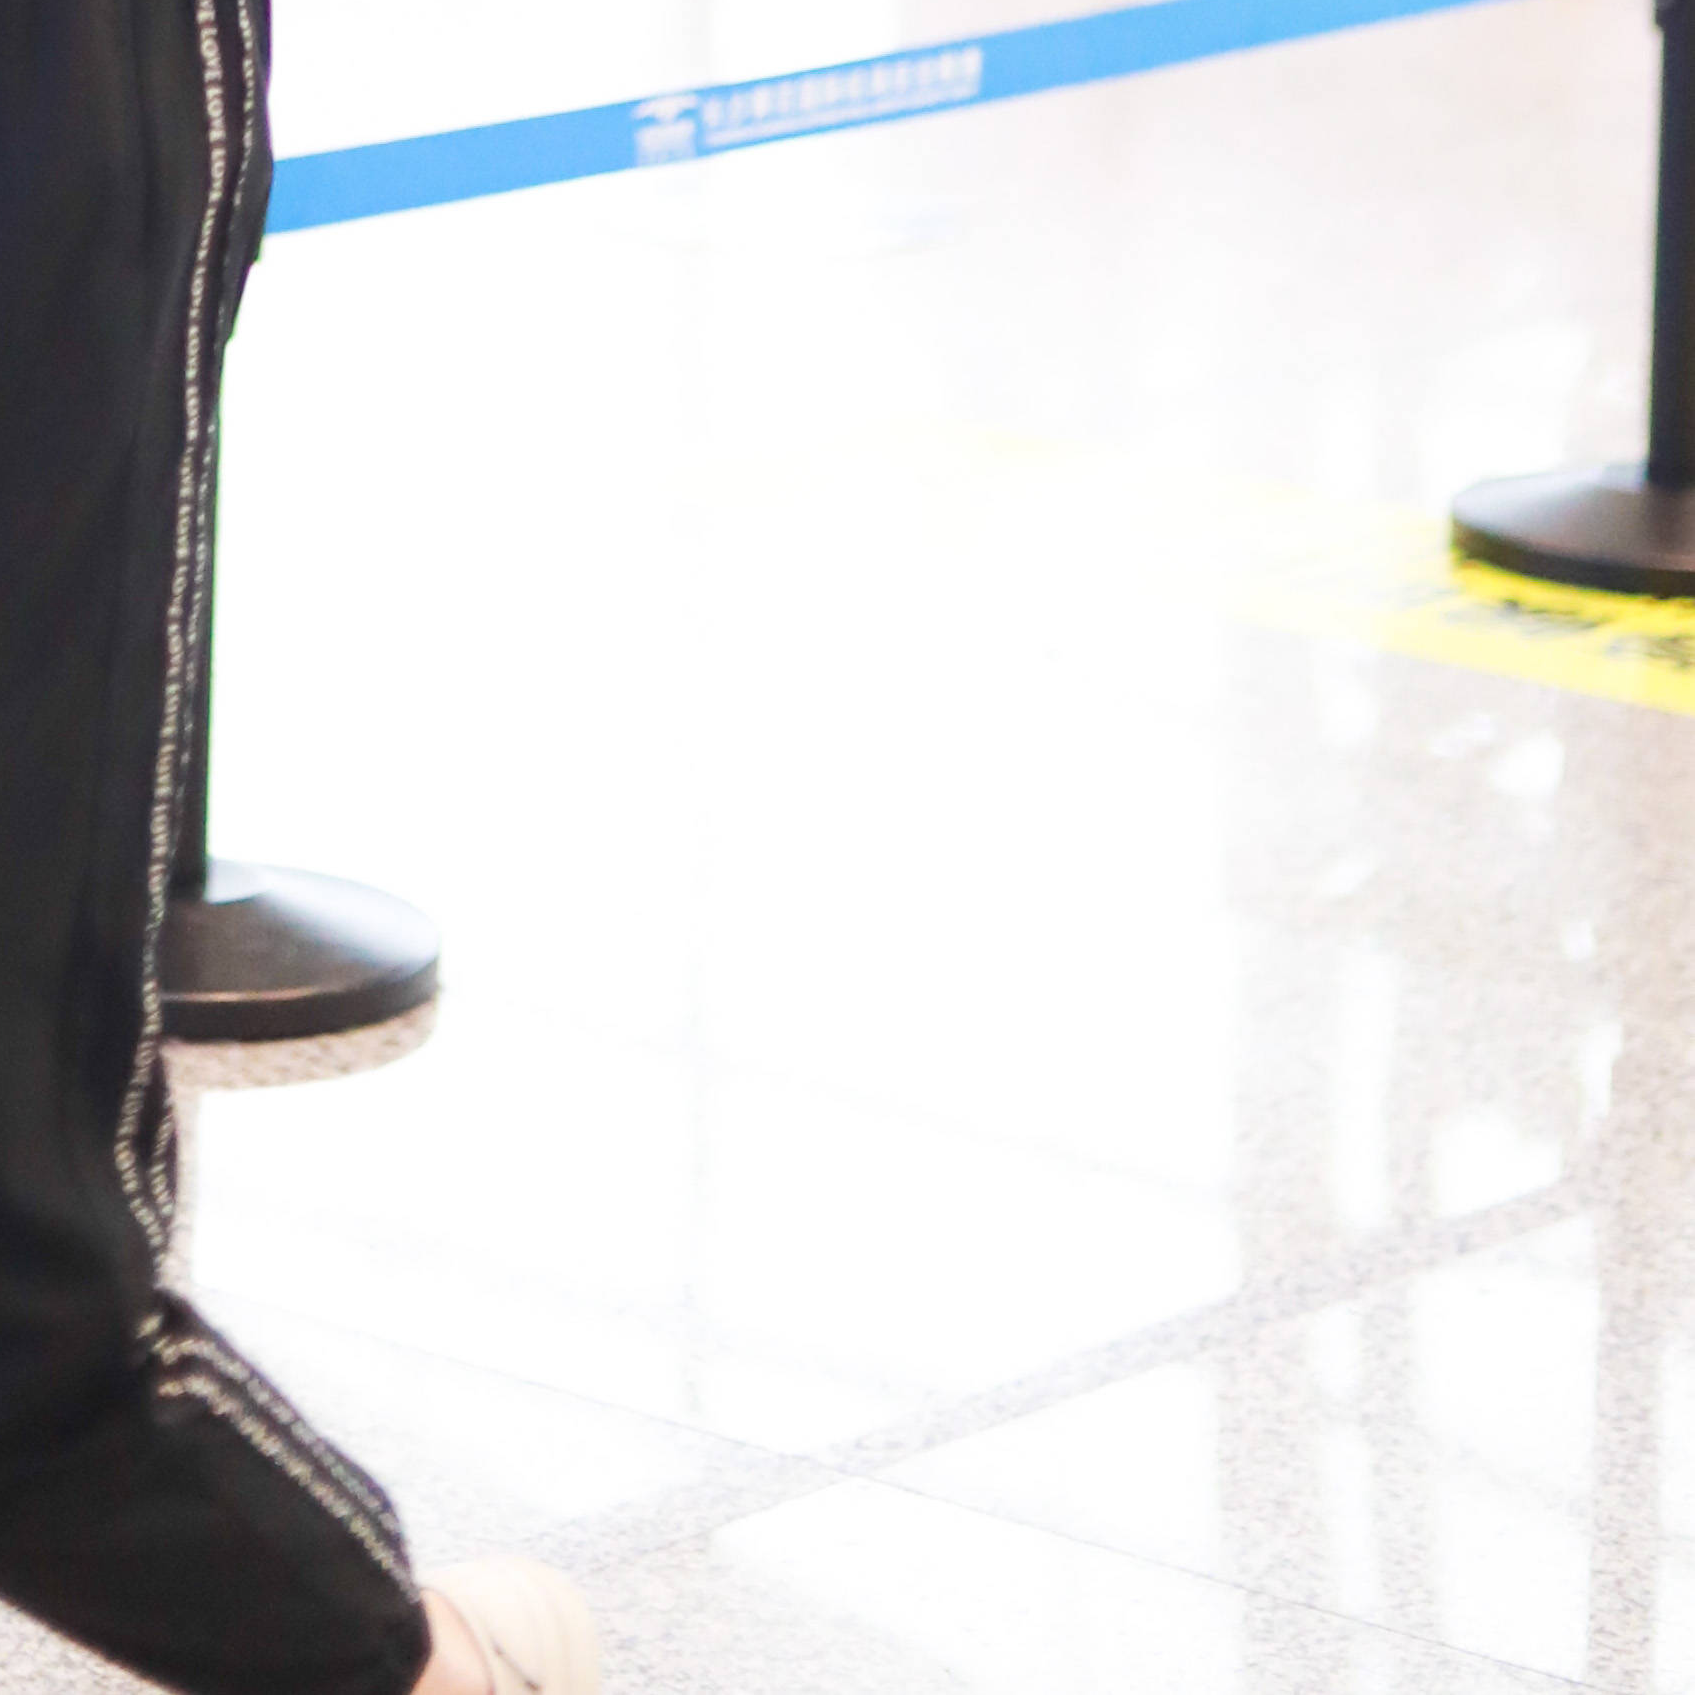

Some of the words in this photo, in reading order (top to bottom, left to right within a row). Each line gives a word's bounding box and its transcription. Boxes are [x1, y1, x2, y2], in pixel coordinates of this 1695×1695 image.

[200, 27, 223, 82] LOVE
[206, 86, 226, 143] LOVE
[208, 148, 226, 203] LOVE
